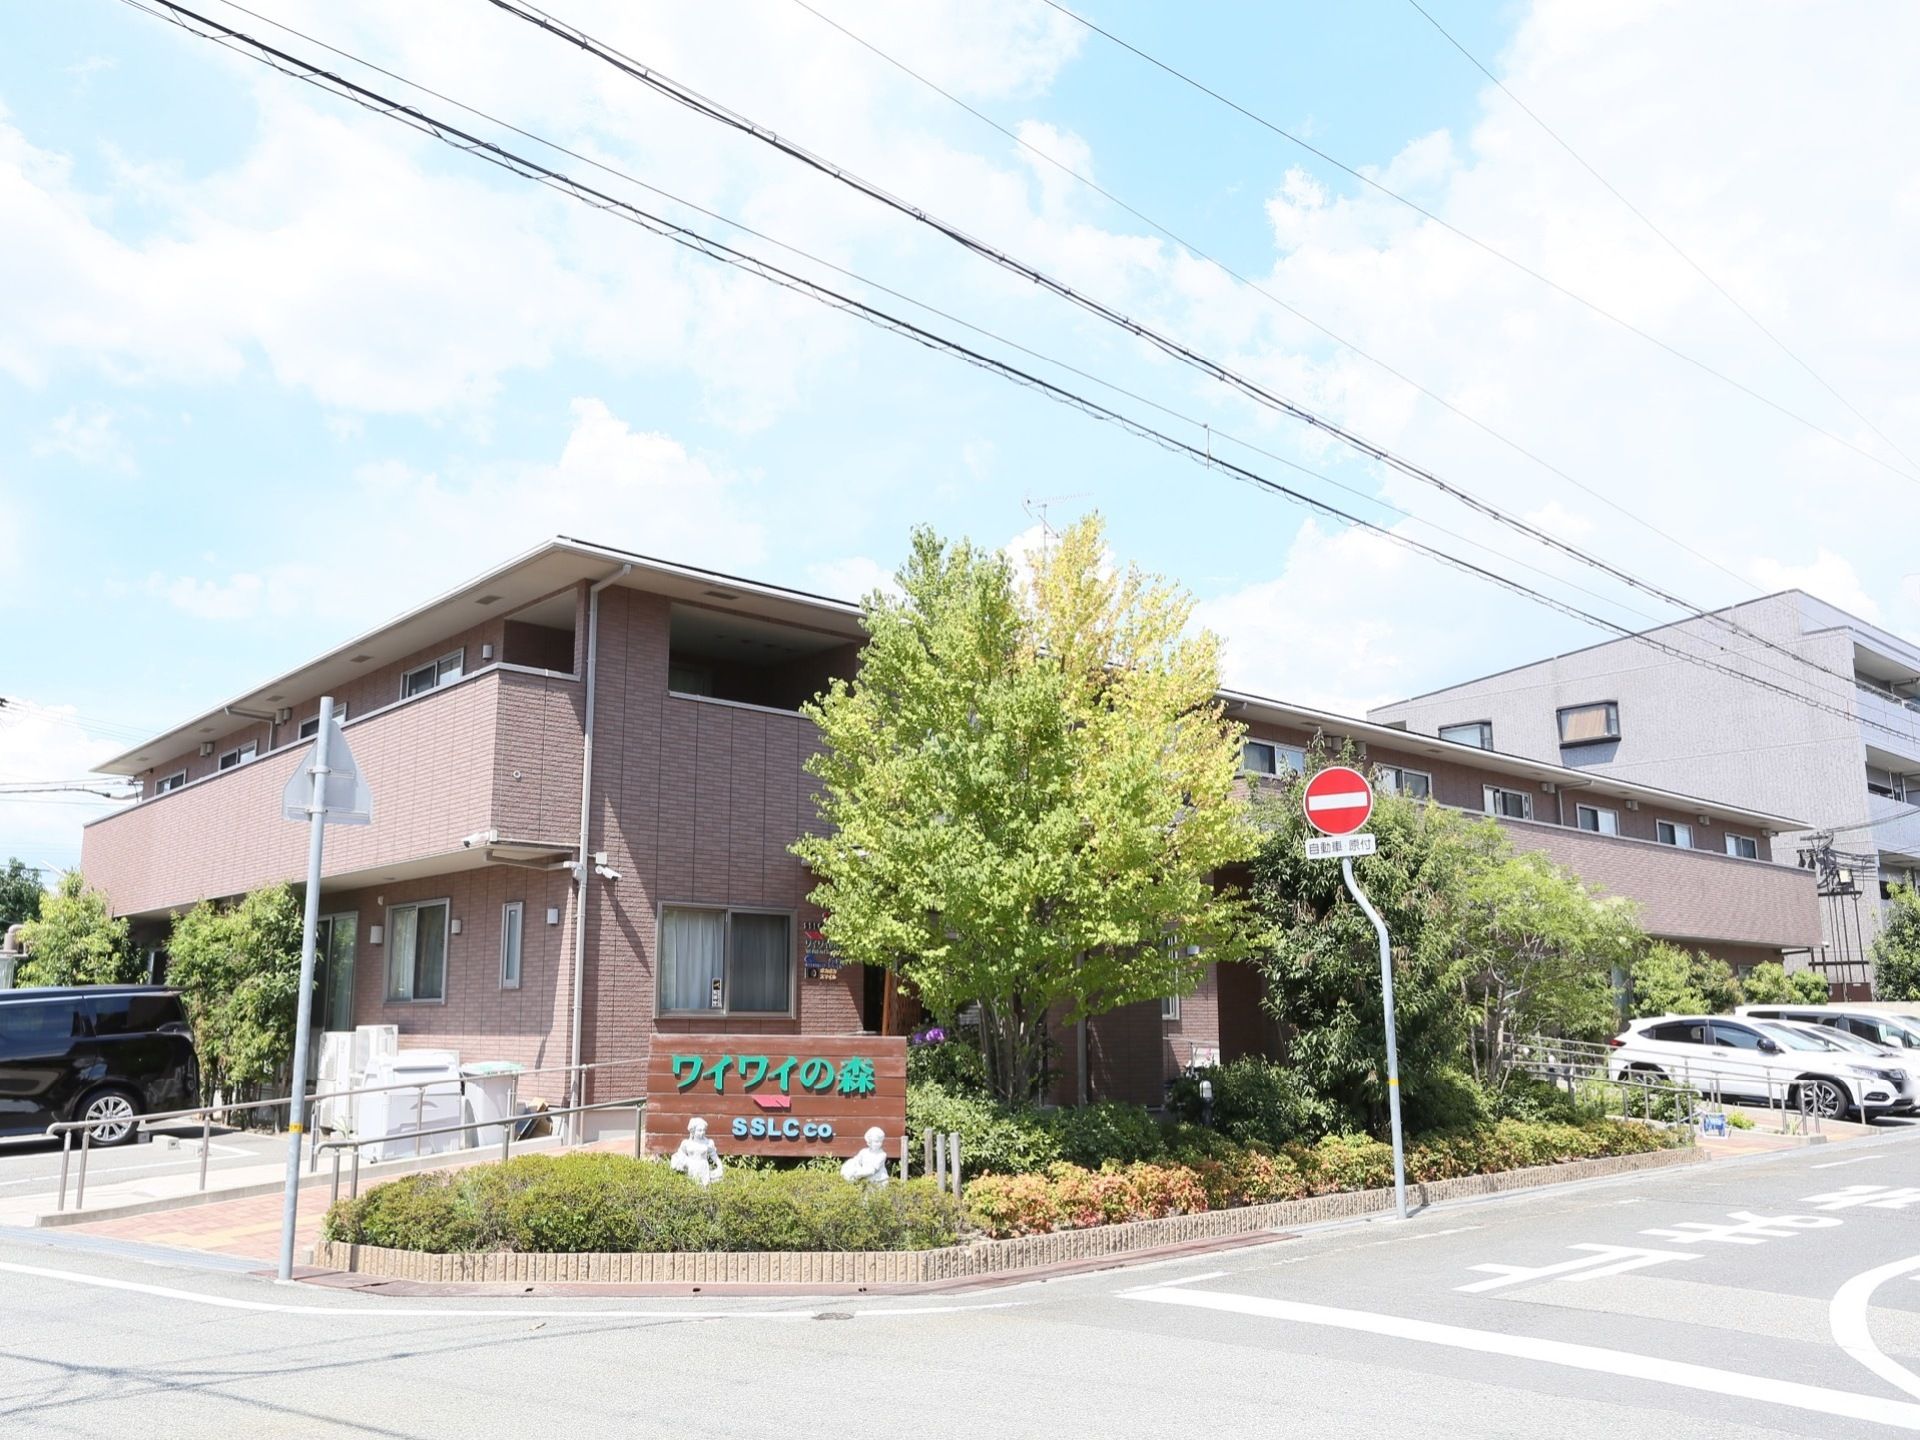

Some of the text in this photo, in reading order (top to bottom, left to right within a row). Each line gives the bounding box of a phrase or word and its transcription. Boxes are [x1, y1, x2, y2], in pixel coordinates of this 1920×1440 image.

[1309, 839, 1371, 855] 自動車 原付
[672, 1055, 876, 1093] ワイワイの森
[732, 1117, 800, 1137] SSLC
